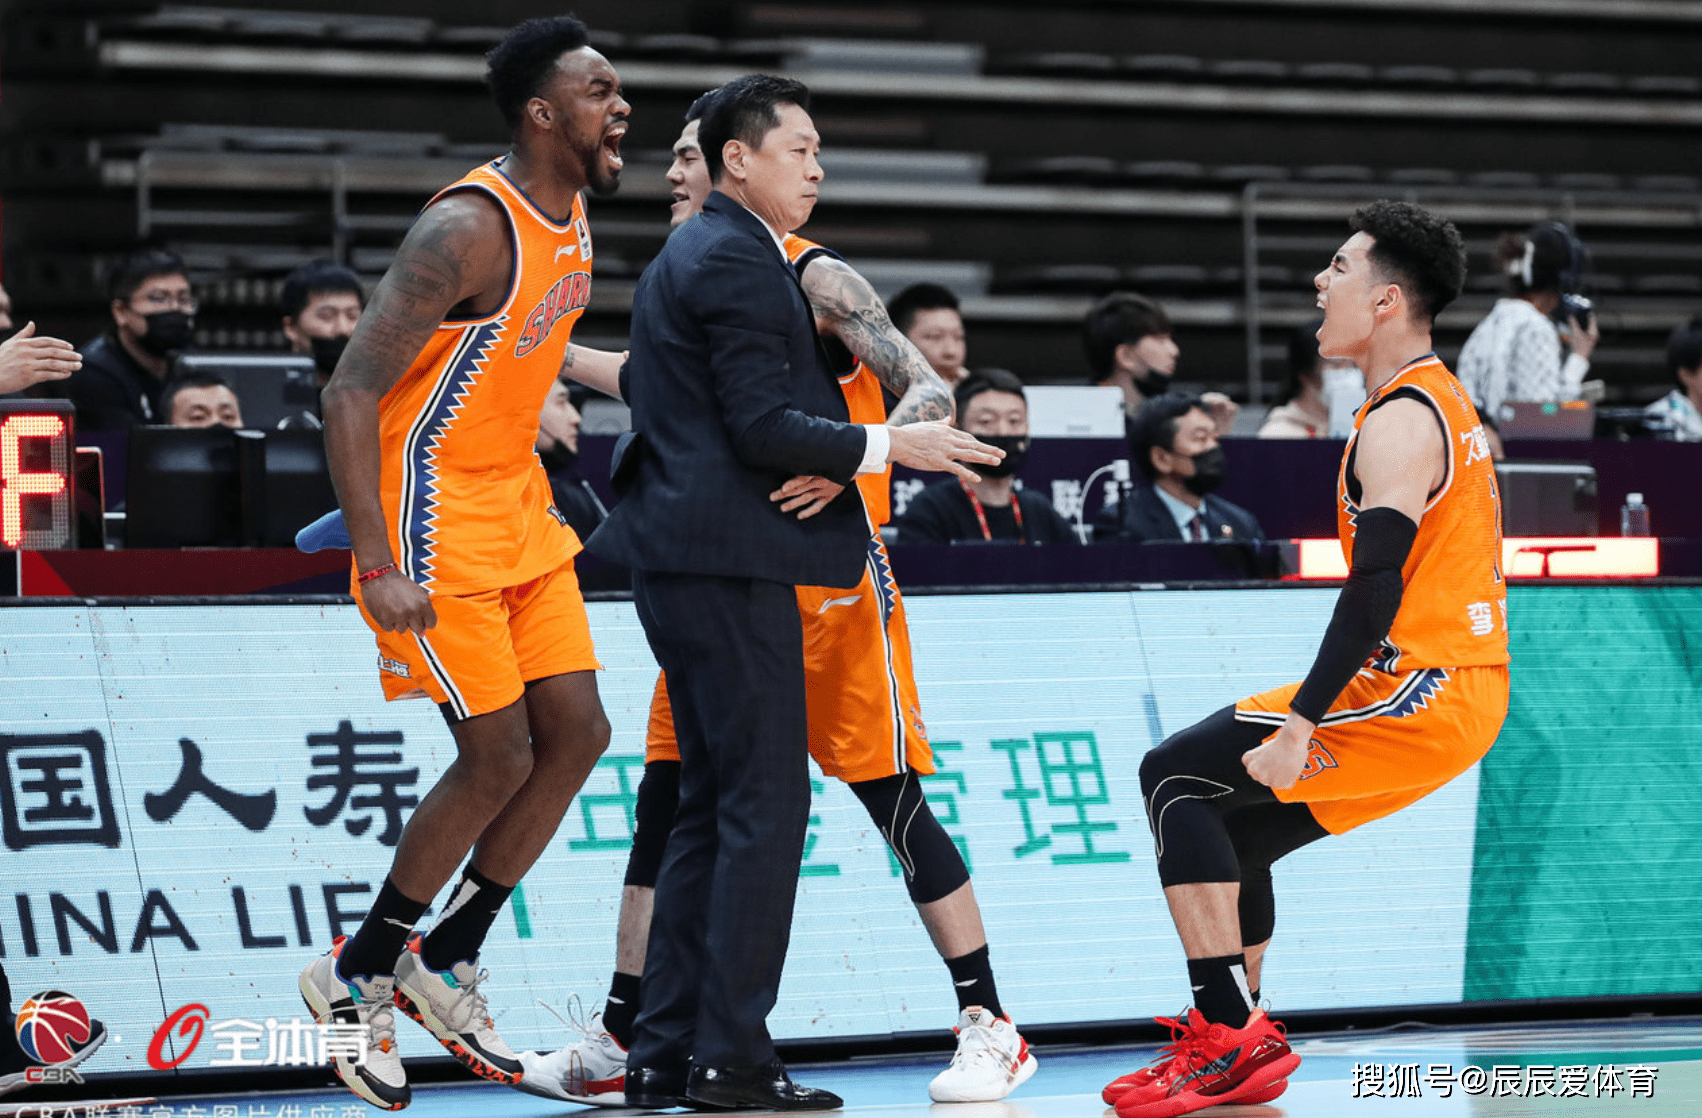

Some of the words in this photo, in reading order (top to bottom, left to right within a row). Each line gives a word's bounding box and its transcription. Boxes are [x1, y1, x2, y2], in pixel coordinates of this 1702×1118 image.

[0, 720, 420, 851] 国人寿
[0, 889, 200, 958] INA
[232, 880, 433, 949] LIF
